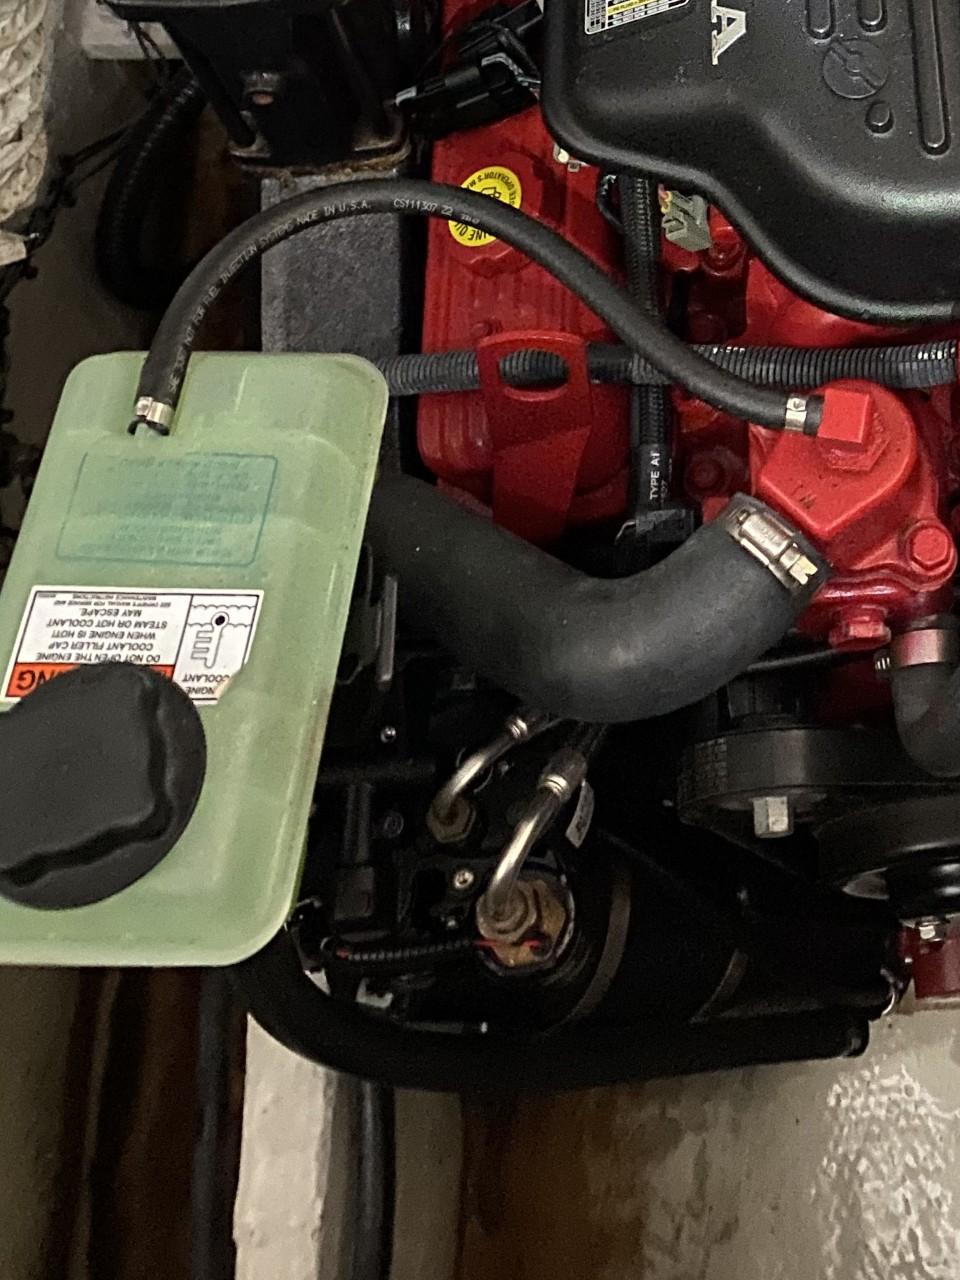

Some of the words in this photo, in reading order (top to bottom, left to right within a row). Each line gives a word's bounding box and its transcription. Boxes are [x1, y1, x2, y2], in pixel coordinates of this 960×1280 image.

[323, 205, 335, 216] IN
[79, 608, 119, 617] ESCAPE.
[122, 609, 141, 617] MAY
[46, 618, 93, 627] COOLANT
[94, 619, 115, 628] HOT
[117, 620, 131, 629] OR
[134, 620, 168, 629] STEAM
[77, 630, 86, 639] IS
[88, 631, 125, 639] ENGINE
[127, 631, 156, 639] WHEN
[48, 641, 70, 650] CAP
[72, 641, 105, 650] FILLER
[107, 642, 153, 651] COOLANT
[36, 652, 72, 661] ENGINE
[74, 653, 92, 662] THE
[123, 654, 144, 662] NOT
[146, 654, 161, 662] DO
